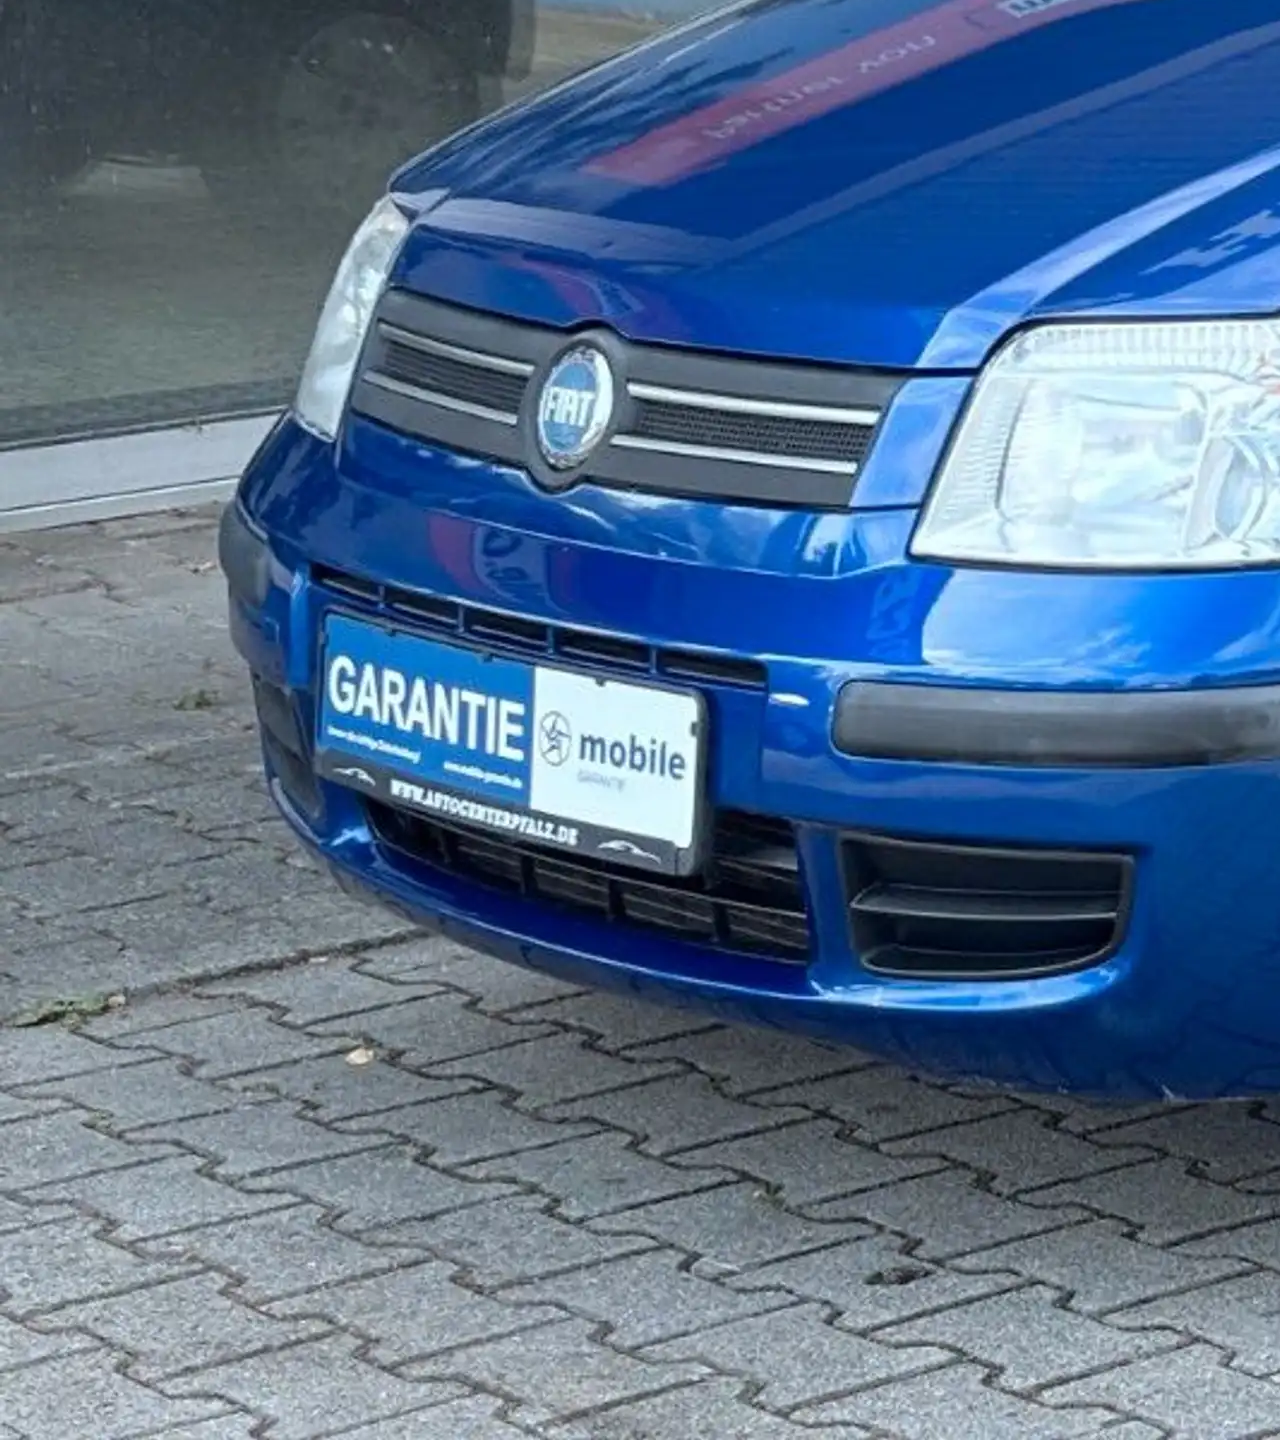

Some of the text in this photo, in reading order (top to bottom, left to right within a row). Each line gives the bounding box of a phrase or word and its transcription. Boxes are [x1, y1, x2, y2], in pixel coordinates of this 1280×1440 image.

[543, 386, 596, 427] FIAT
[328, 654, 526, 763] GARANTIE
[578, 733, 687, 781] mobile
[390, 778, 580, 846] WWW.AUTOCENTERPFALZ.DE
